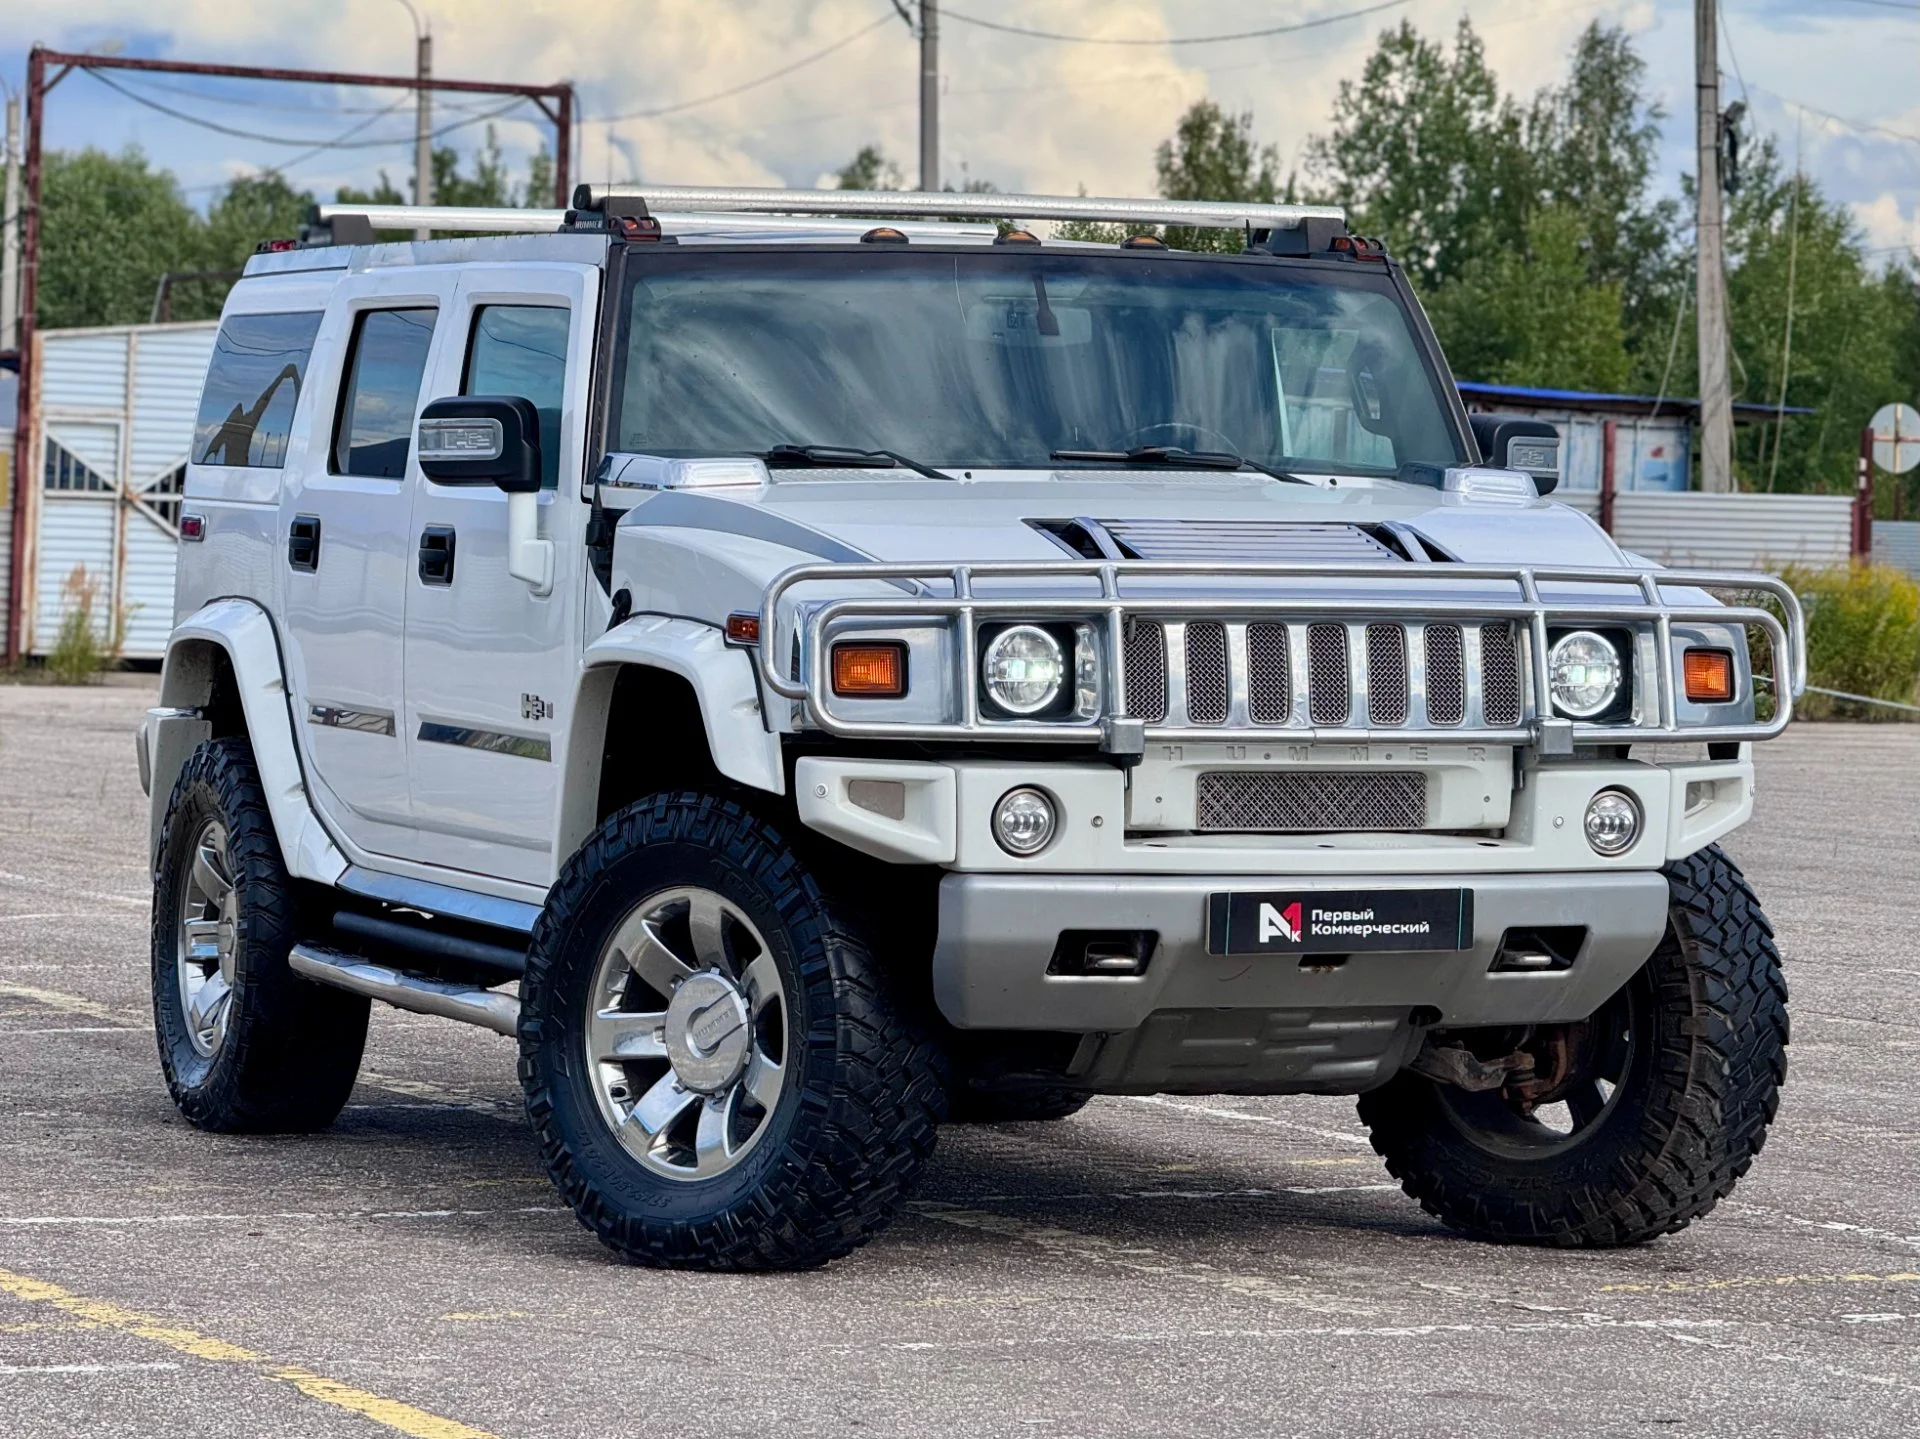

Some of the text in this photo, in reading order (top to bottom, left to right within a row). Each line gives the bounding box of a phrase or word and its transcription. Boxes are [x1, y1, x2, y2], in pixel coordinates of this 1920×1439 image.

[1161, 746, 1486, 762] HUMMER
[1311, 908, 1374, 924] Первый
[1311, 921, 1430, 938] Коммерческий
